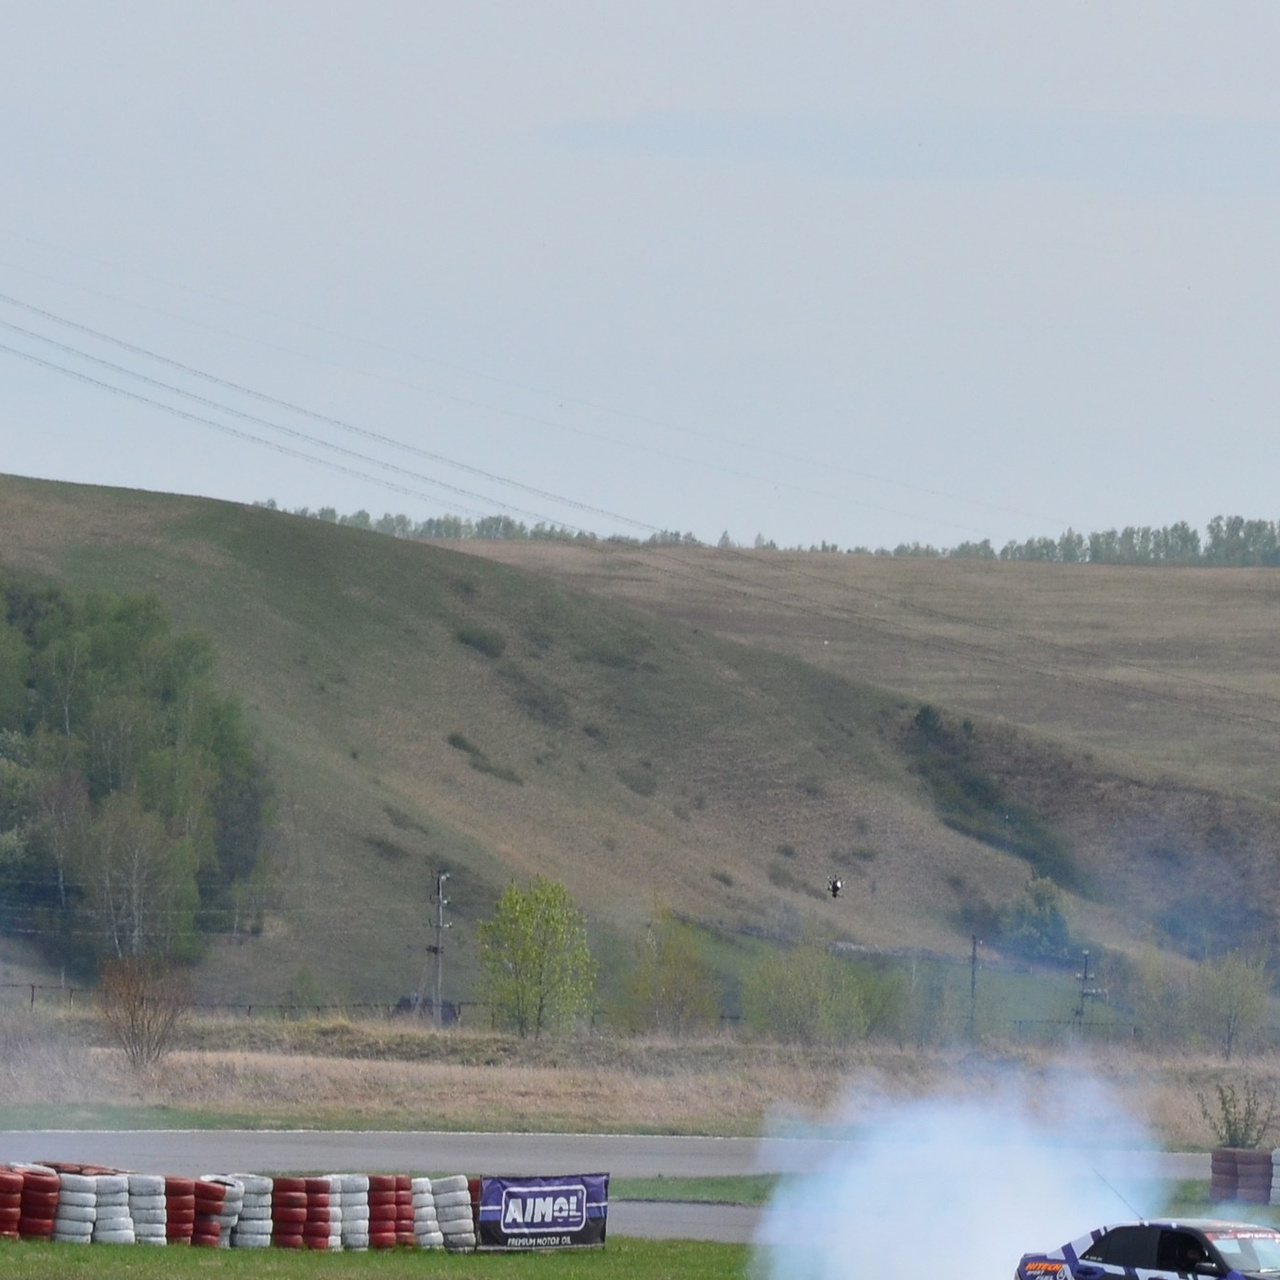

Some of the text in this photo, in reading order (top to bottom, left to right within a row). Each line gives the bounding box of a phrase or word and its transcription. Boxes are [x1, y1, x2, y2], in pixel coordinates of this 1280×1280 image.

[505, 1195, 581, 1223] AIMOL
[507, 1237, 536, 1247] PREMIUM
[537, 1236, 560, 1246] MOTOR
